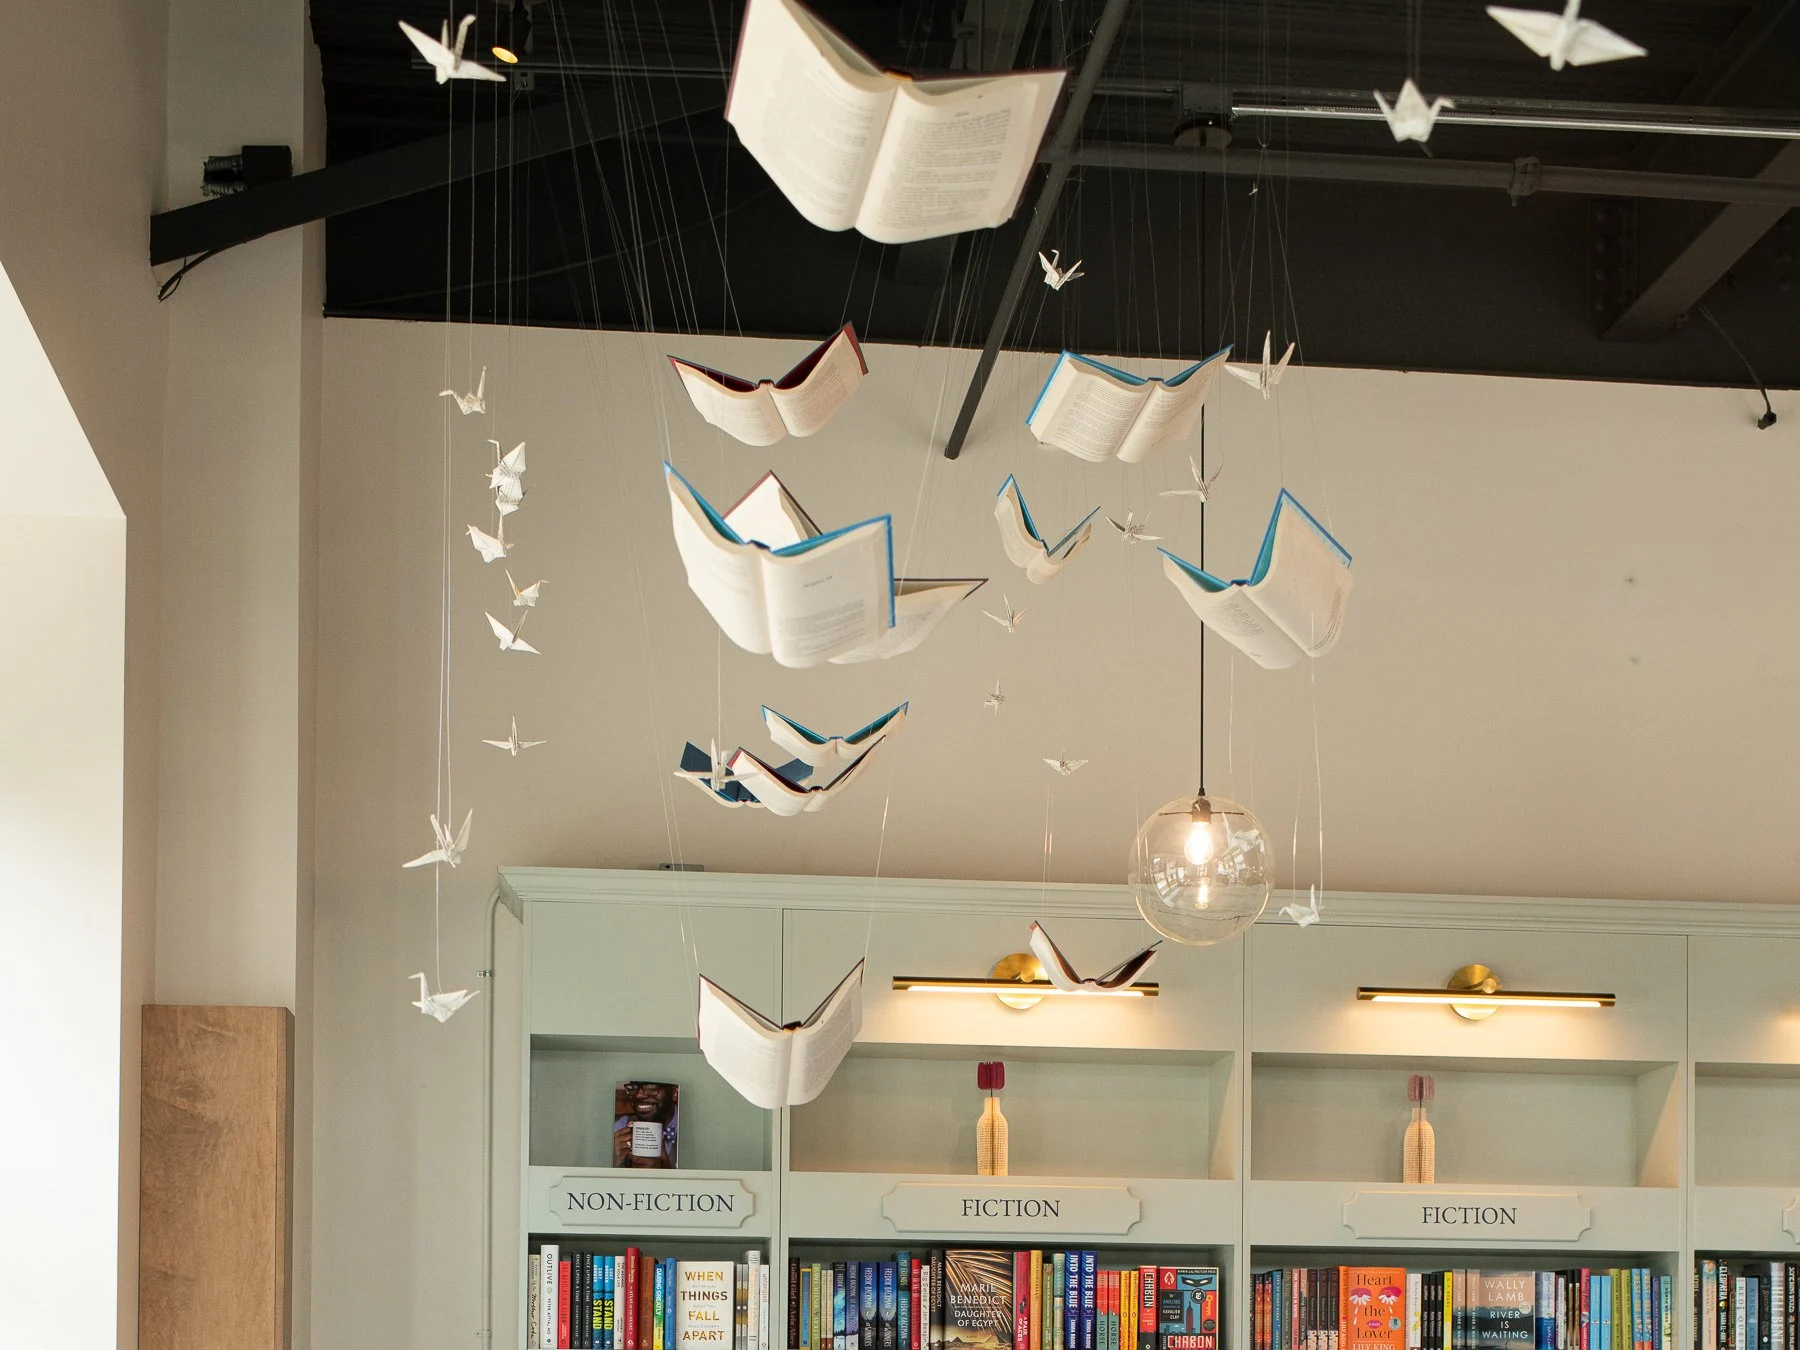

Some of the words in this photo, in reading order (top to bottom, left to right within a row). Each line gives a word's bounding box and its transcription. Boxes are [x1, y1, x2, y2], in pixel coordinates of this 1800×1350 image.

[567, 1192, 735, 1212] NON-FICTION
[962, 1199, 1060, 1218] FICTION
[1422, 1206, 1518, 1225] FICTION
[1070, 1255, 1079, 1272] INTO
[1086, 1255, 1095, 1272] INTO
[685, 1271, 724, 1281] WHEN
[1069, 1274, 1078, 1289] THE
[1085, 1274, 1094, 1289] THE
[1356, 1273, 1393, 1286] Heart
[960, 1284, 997, 1292] MARIE
[1144, 1272, 1154, 1308] CHABON
[1484, 1279, 1525, 1291] WALLY
[681, 1291, 728, 1301] THINGS
[950, 1296, 1006, 1304] BENEDICT
[1069, 1291, 1078, 1308] BLUE
[1085, 1291, 1094, 1308] BLUE
[1488, 1292, 1525, 1302] LAMB
[593, 1300, 603, 1330] STAND
[604, 1300, 614, 1330] STAND
[688, 1311, 720, 1321] FALL
[954, 1310, 1003, 1318] DAUGHTER
[1364, 1305, 1386, 1317] the
[1490, 1310, 1521, 1320] RIVER
[1500, 1320, 1510, 1329] IS
[682, 1331, 724, 1341] APART
[1357, 1328, 1393, 1339] Lover
[1481, 1330, 1529, 1340] WAITING
[1167, 1335, 1213, 1348] CHABON
